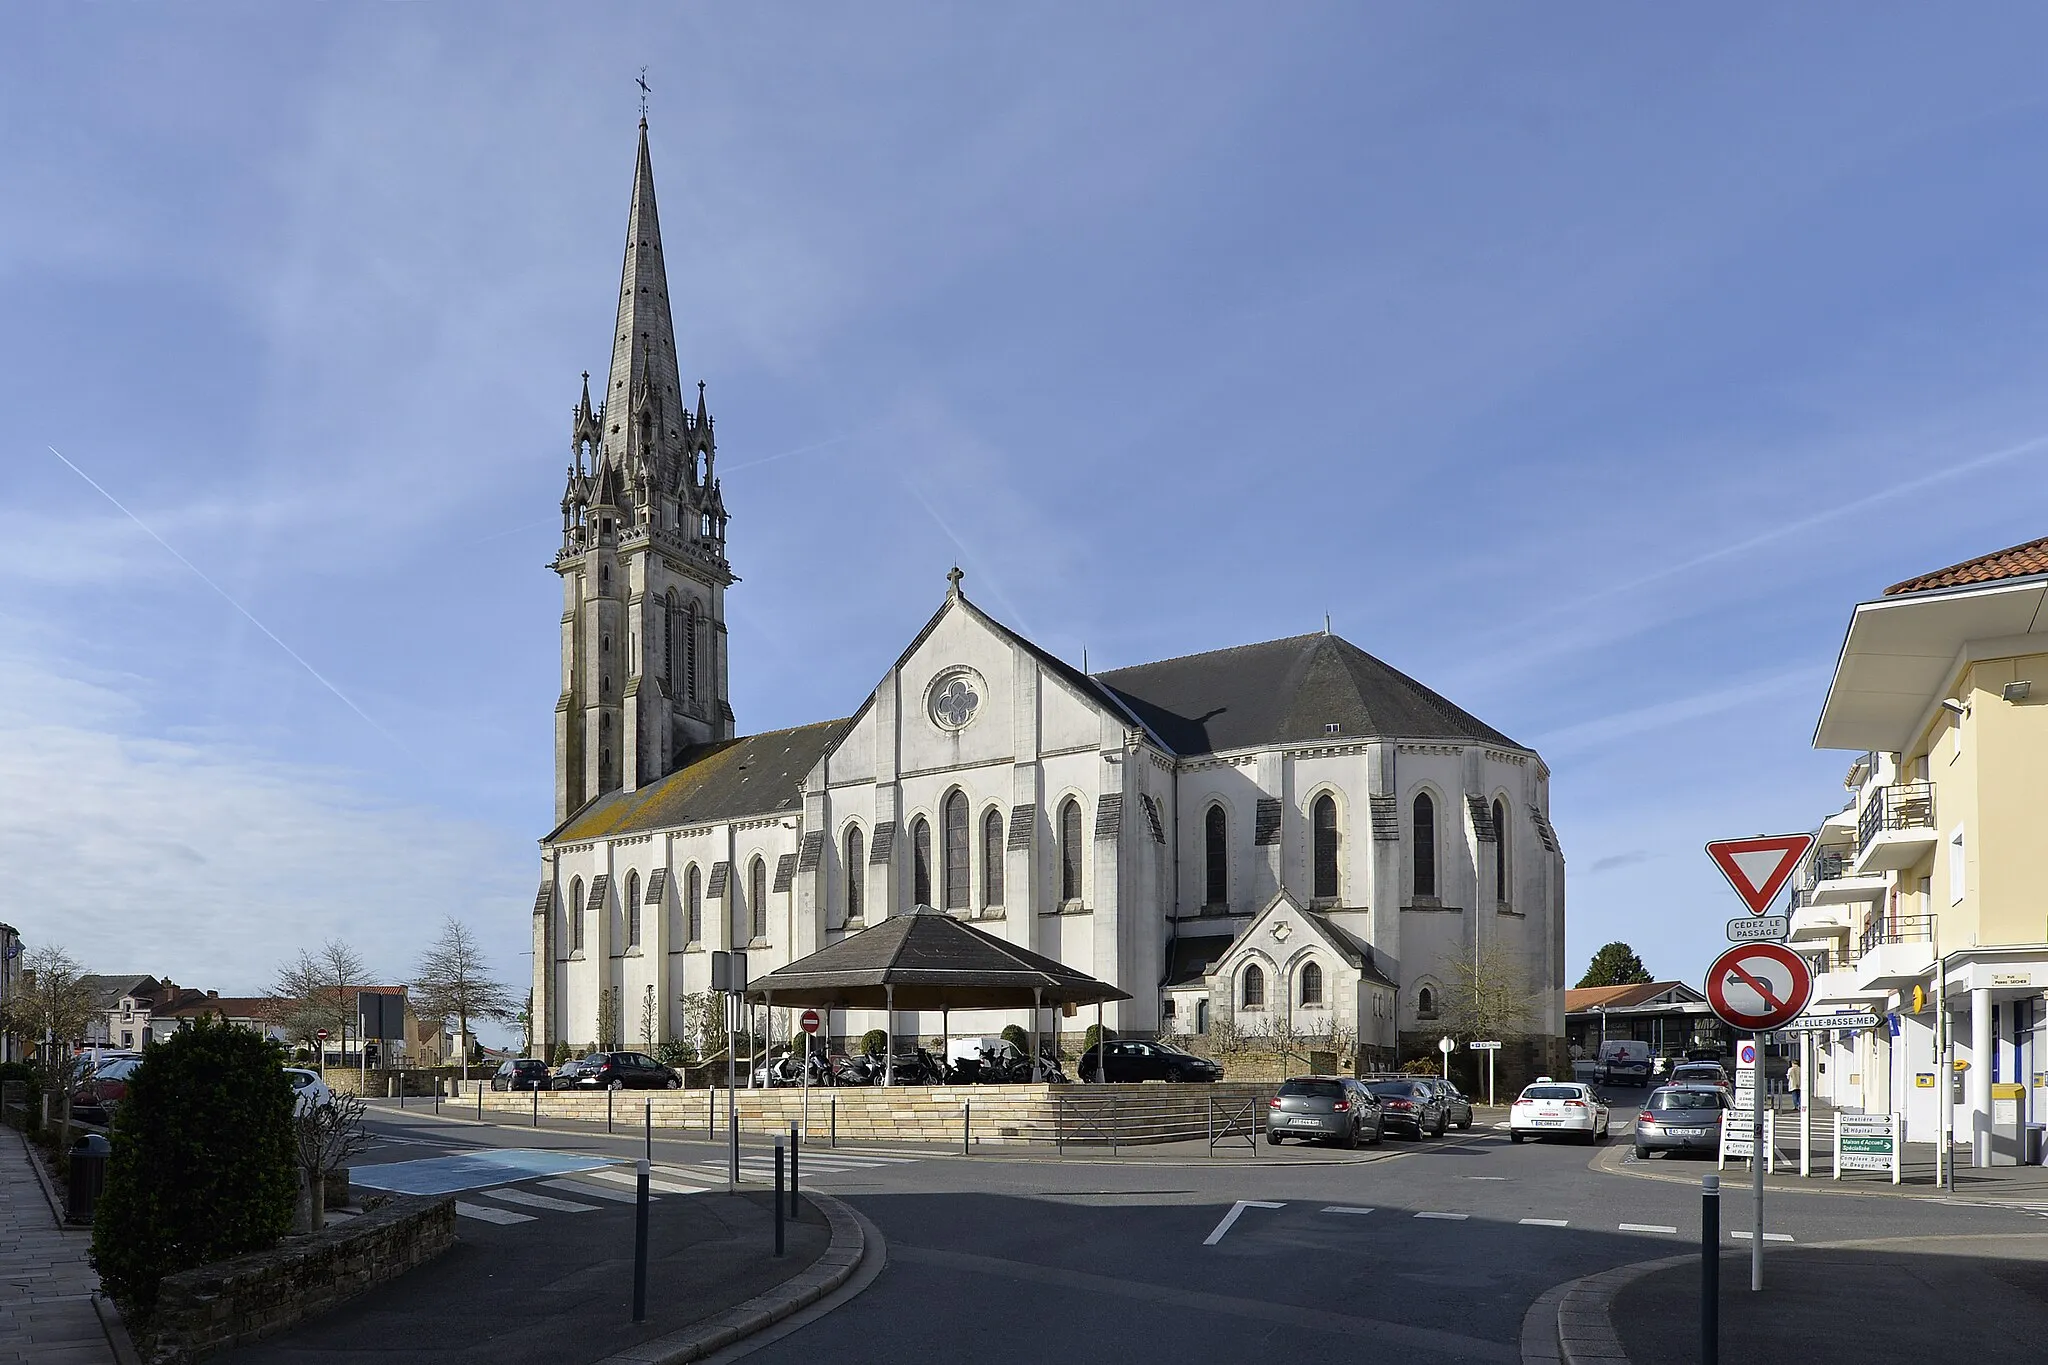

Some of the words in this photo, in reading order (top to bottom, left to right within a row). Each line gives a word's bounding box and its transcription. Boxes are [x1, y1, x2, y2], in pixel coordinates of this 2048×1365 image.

[1734, 920, 1765, 929] CÉDEZ
[1769, 919, 1780, 927] LE
[1736, 928, 1778, 937] PASSAGE
[1785, 1016, 1875, 1028] HAELLE-BASSE-MER
